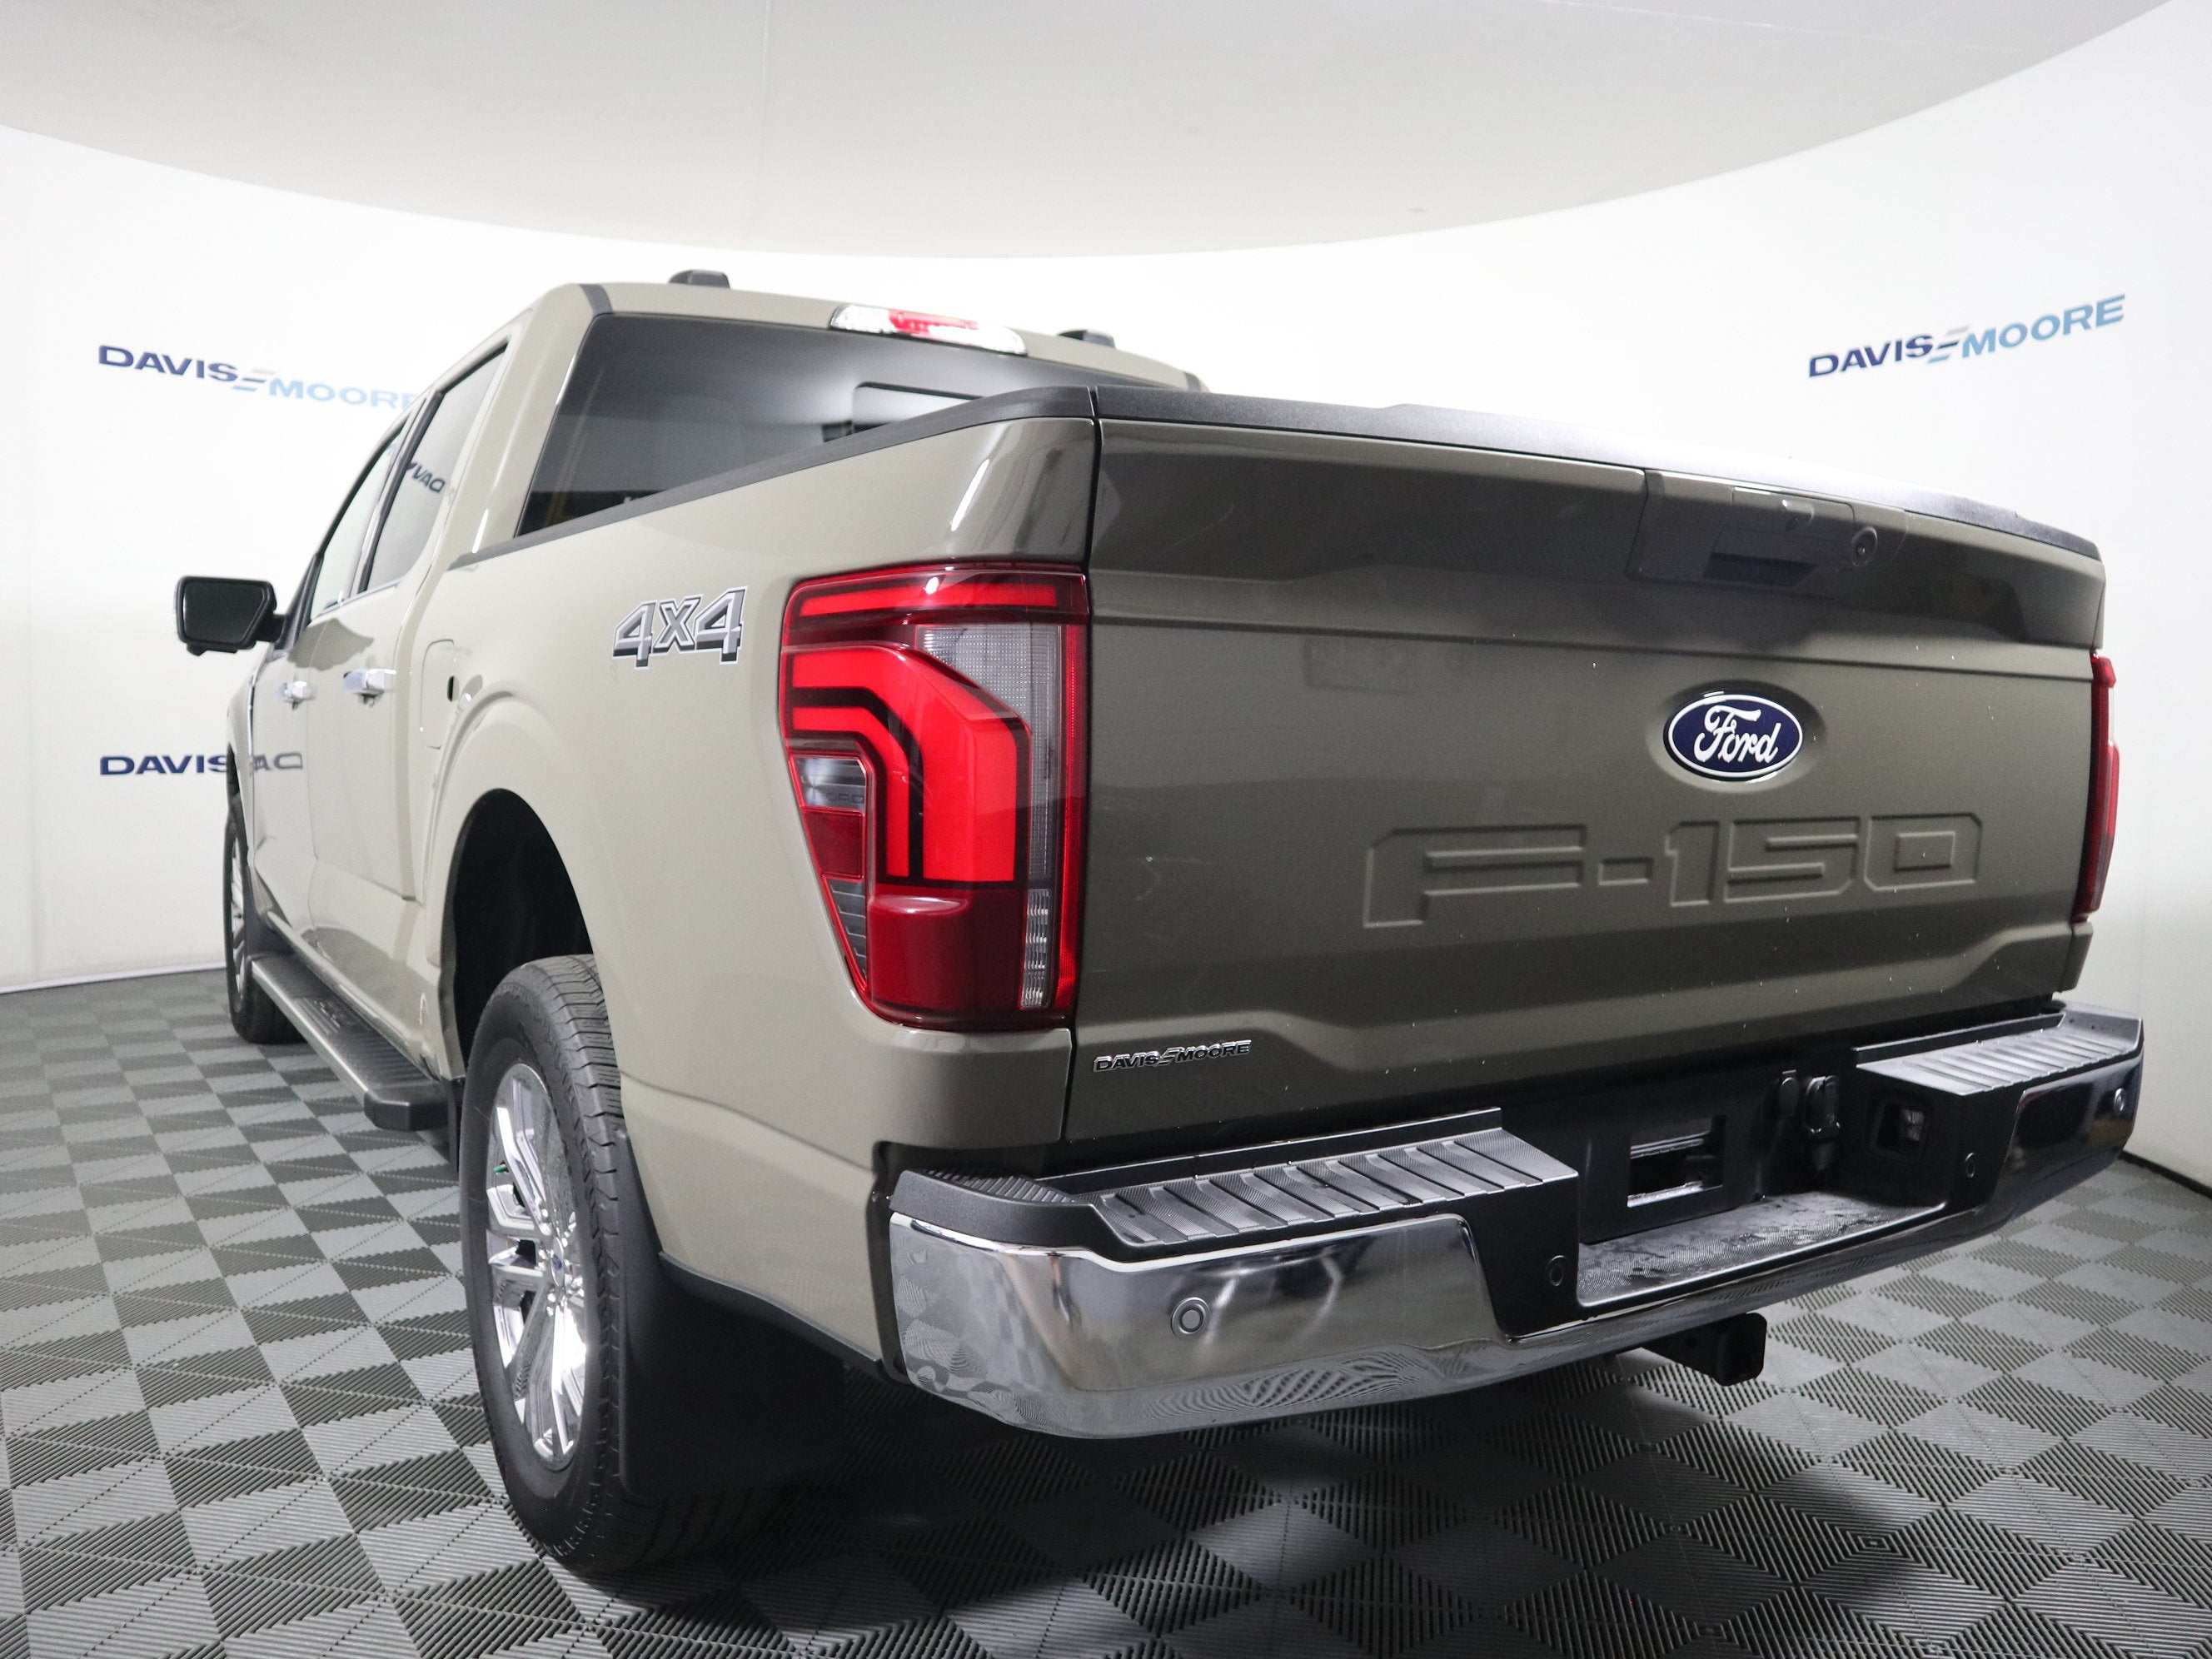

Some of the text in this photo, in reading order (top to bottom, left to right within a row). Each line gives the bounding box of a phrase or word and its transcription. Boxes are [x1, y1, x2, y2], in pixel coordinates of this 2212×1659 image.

[98, 345, 238, 382] DAVIS
[1809, 293, 2125, 378] DAVIS MOORE
[612, 586, 748, 670] 4X4
[1694, 705, 1781, 764] Ford
[1363, 813, 1983, 928] F-150
